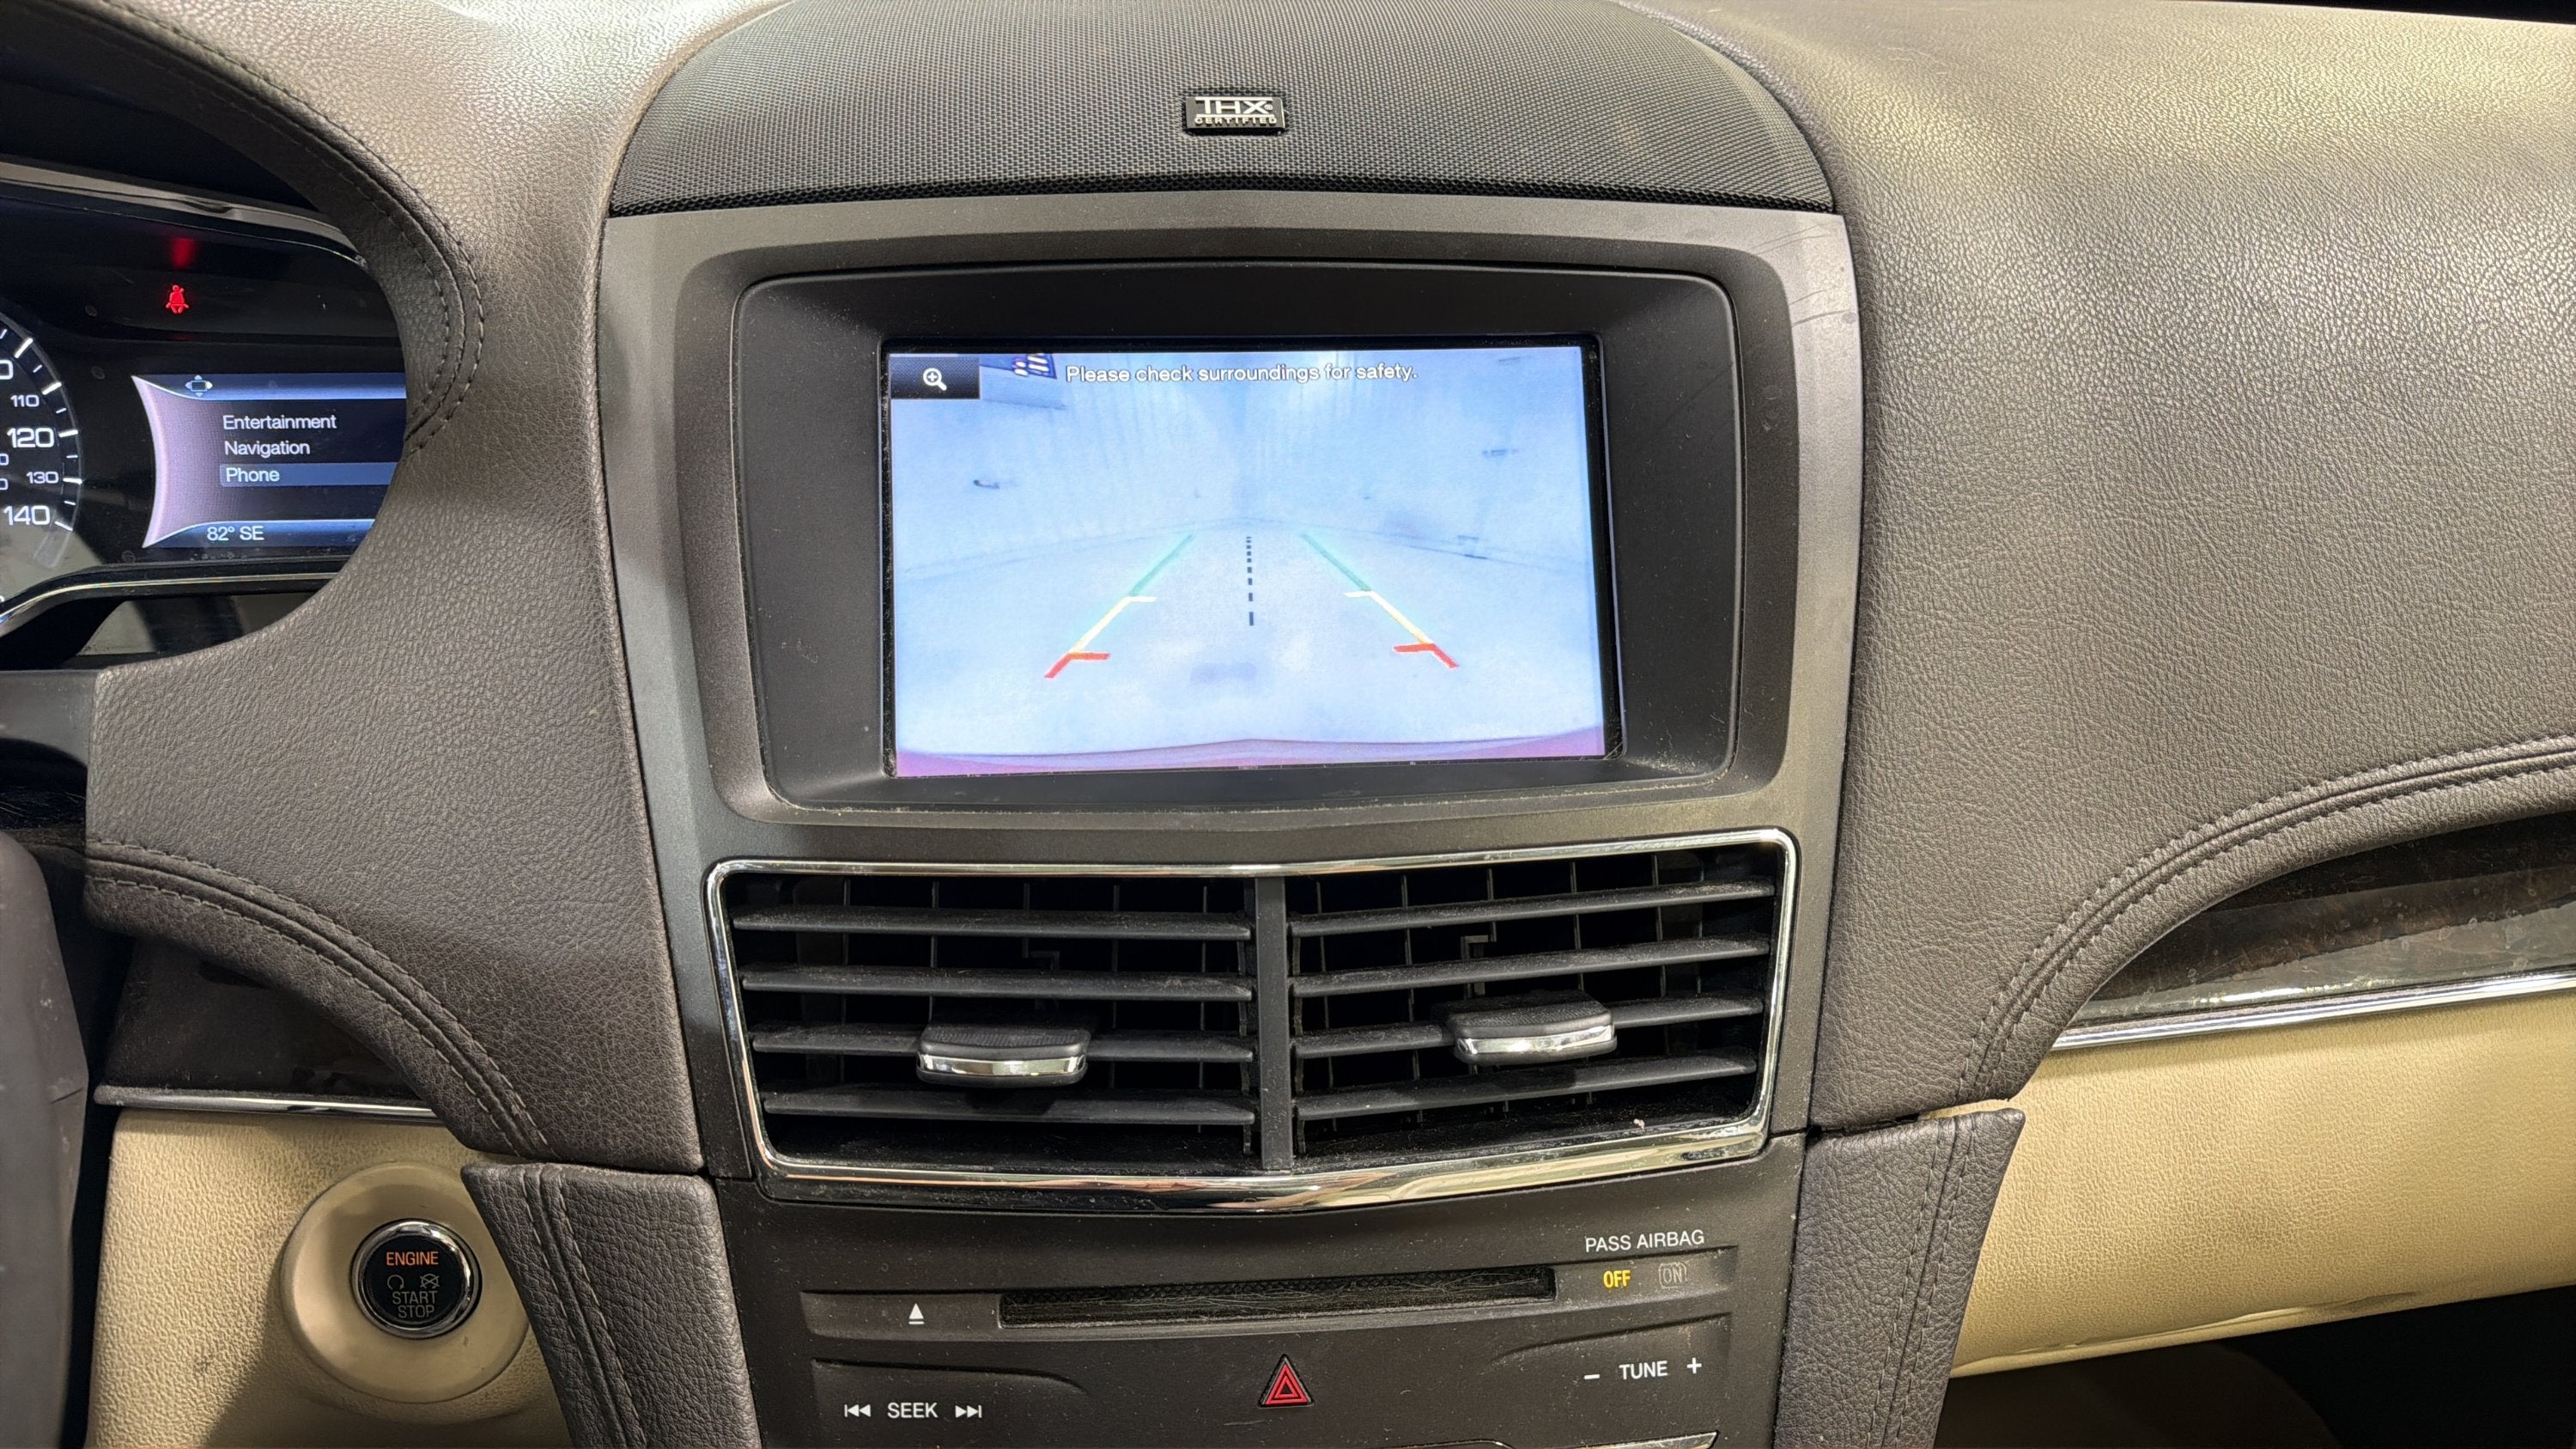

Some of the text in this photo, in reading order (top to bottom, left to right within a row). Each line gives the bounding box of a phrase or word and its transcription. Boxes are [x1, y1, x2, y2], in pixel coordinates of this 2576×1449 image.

[1194, 116, 1277, 126] CERTIFIED
[1066, 362, 1418, 384] Please check surroundings for safety.
[10, 394, 39, 407] 110
[222, 414, 337, 430] Entertainment
[7, 428, 54, 447] 120
[224, 440, 311, 459] Navigation
[26, 471, 59, 484] 130
[226, 467, 280, 483] Phone
[3, 505, 50, 526] 140
[207, 526, 264, 541] 82° SE
[1585, 1229, 1705, 1252] PASS AIRBAG
[386, 1251, 440, 1266] ENGINE
[1603, 1269, 1631, 1288] OFF
[1662, 1264, 1684, 1284] ON
[392, 1290, 438, 1305] START
[398, 1305, 435, 1318] STOP
[1619, 1361, 1668, 1380] TUNE
[887, 1402, 939, 1418] SEEK
